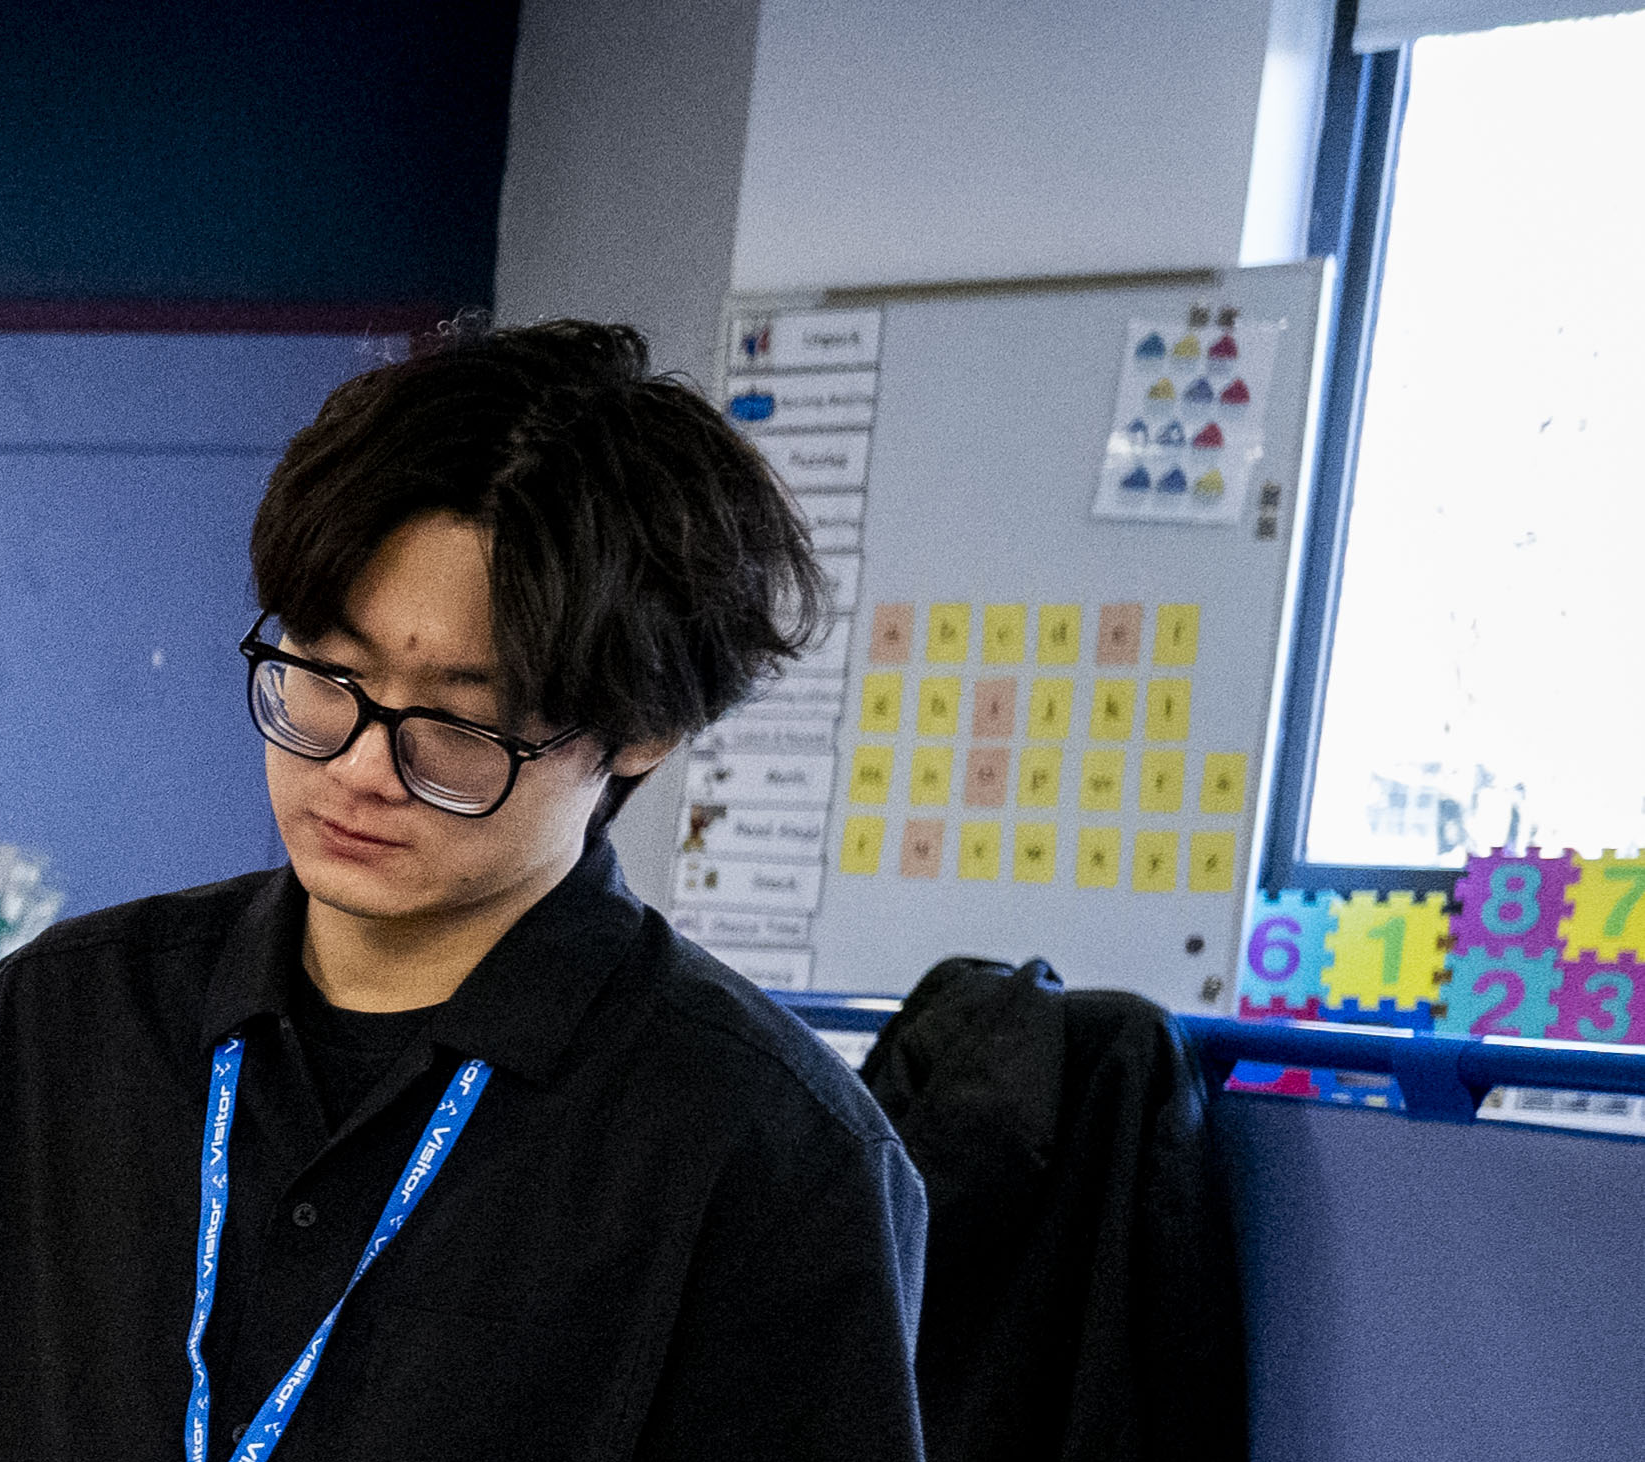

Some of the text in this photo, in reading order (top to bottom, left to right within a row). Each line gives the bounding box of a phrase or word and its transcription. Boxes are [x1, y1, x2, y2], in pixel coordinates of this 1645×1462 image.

[1481, 864, 1645, 938] 8 7
[1248, 916, 1406, 984] 6 1
[1470, 969, 1634, 1043] 2 3
[210, 1085, 231, 1165] Visitor
[401, 1126, 452, 1204] Visitor
[203, 1198, 221, 1278] Visitor
[275, 1337, 323, 1412] Visitor
